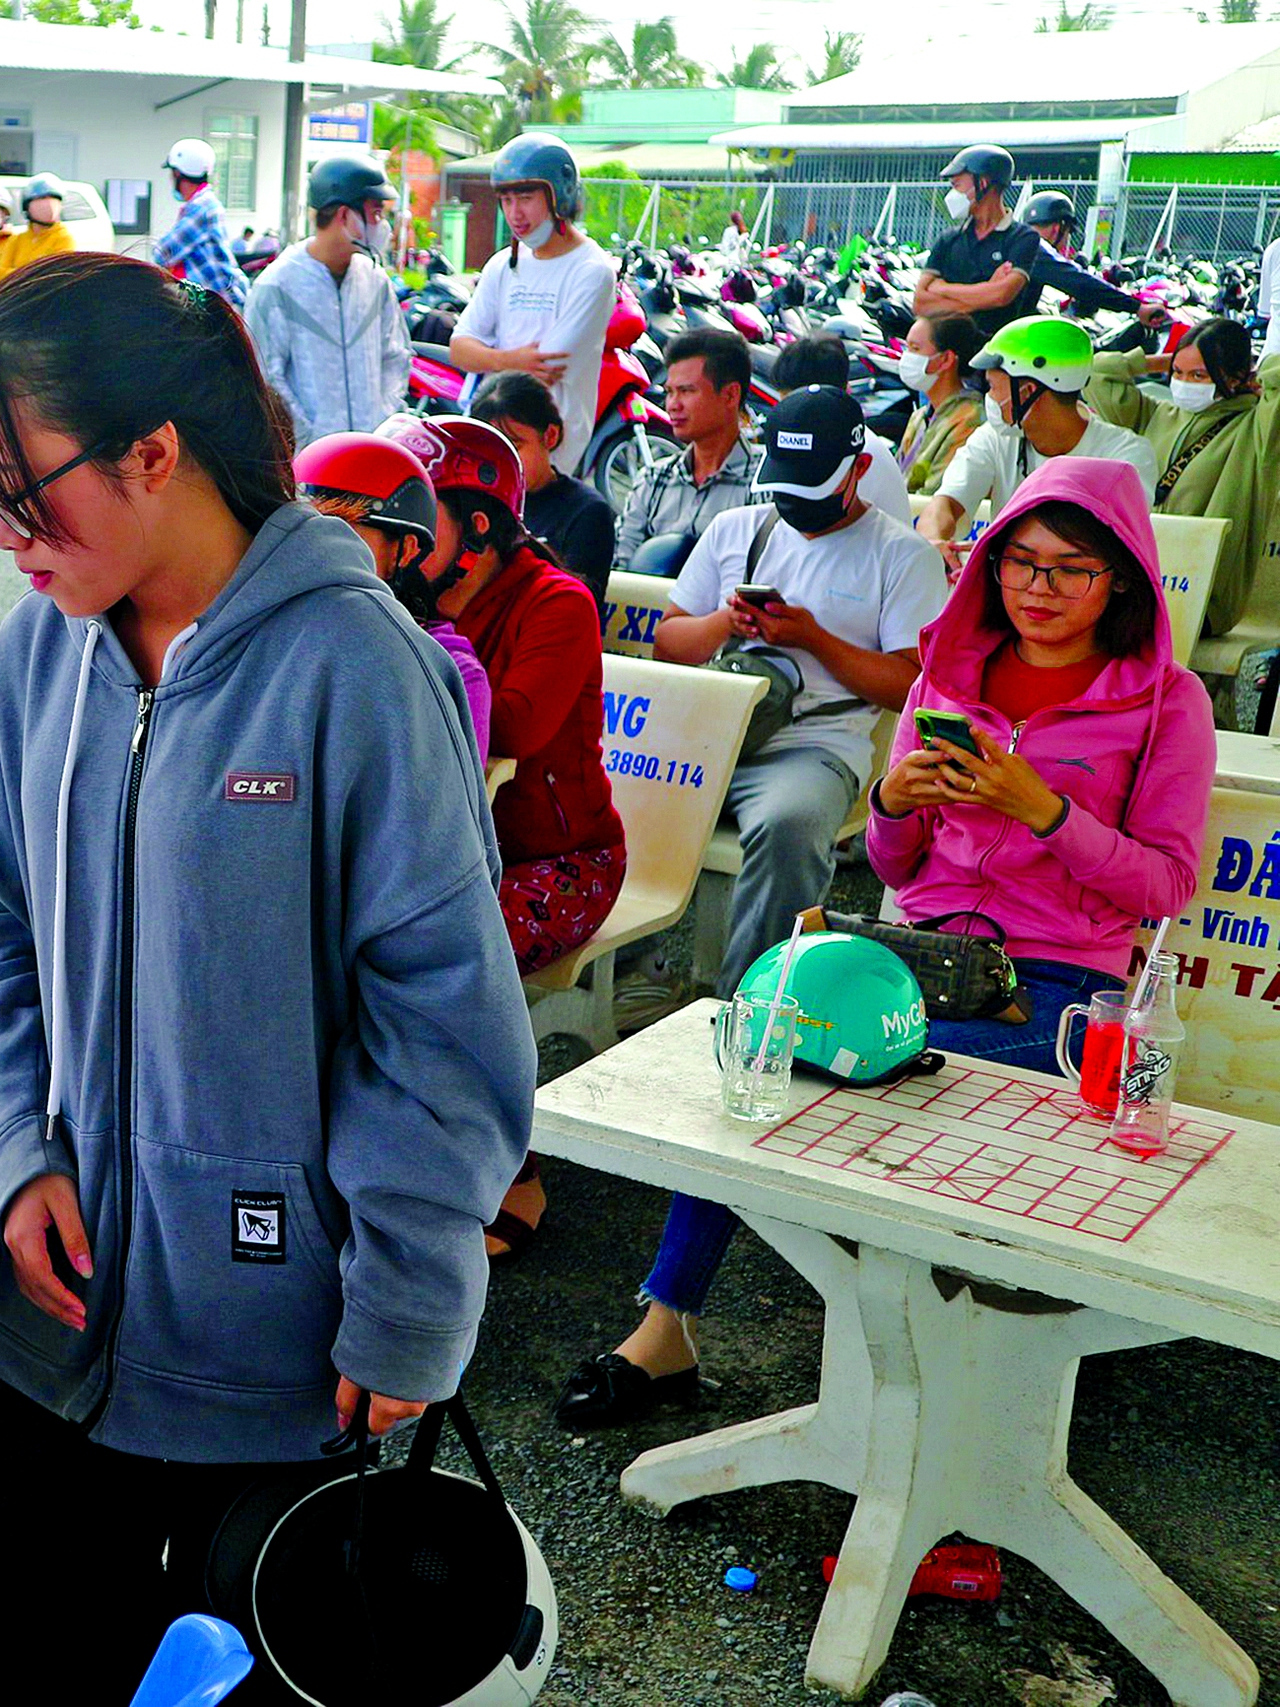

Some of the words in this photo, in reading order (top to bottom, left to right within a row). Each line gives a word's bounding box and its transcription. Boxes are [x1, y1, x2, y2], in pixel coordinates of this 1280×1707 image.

[606, 749, 704, 788] 3890.114
[1202, 907, 1270, 948] Vĩnh
[1126, 1055, 1172, 1093] STING
